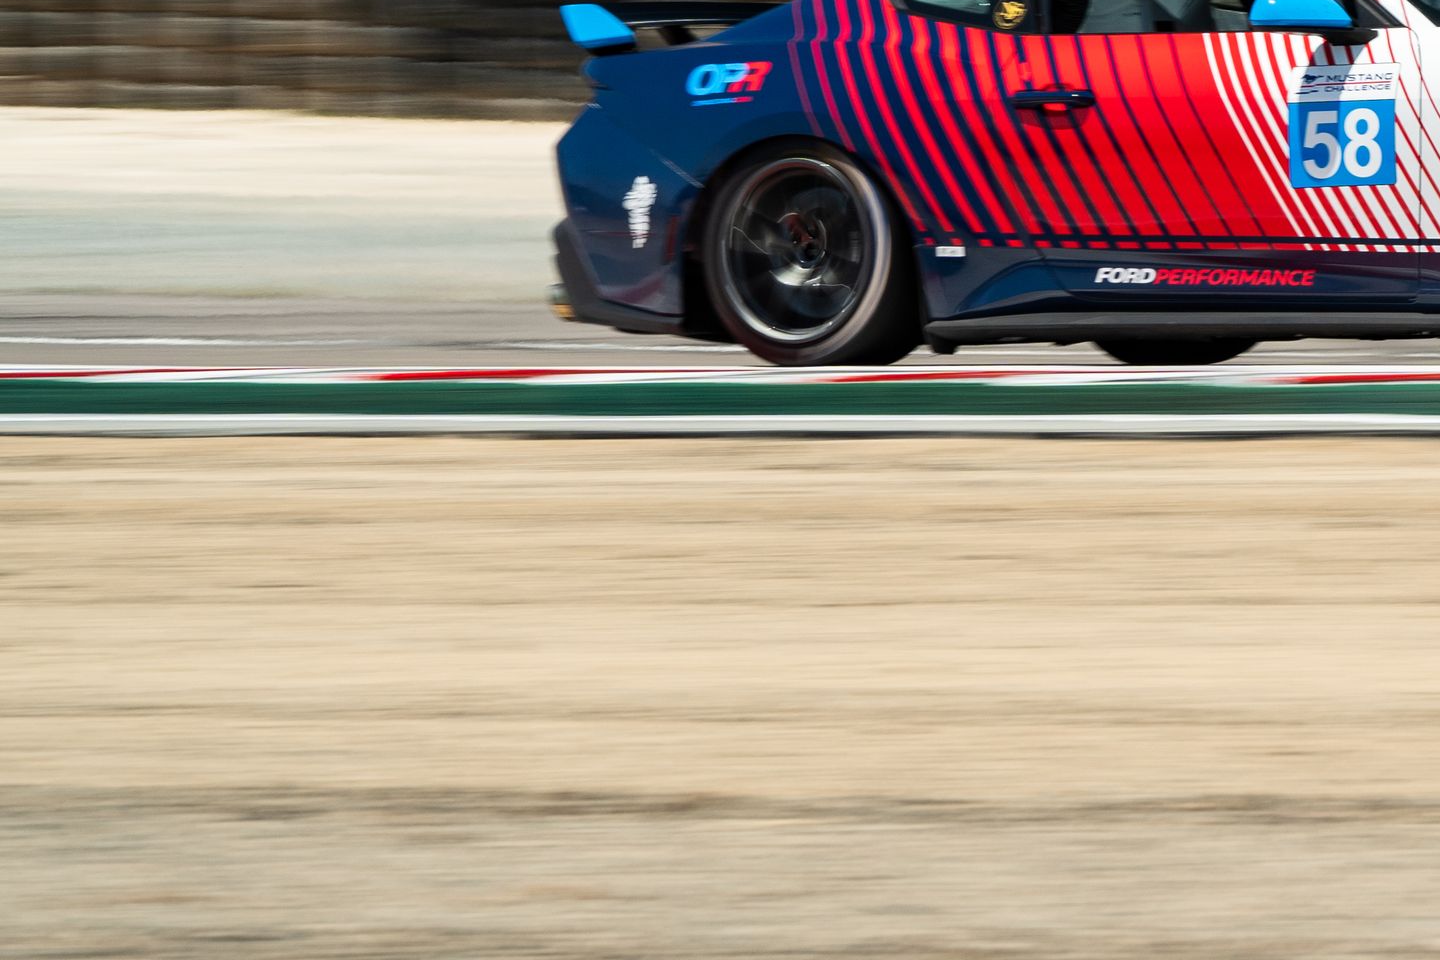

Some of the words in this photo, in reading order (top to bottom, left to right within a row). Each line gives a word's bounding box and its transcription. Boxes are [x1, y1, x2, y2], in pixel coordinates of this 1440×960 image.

[1326, 72, 1393, 82] MUSTANG
[1324, 83, 1391, 93] CHALLENGE
[1303, 107, 1383, 180] 58
